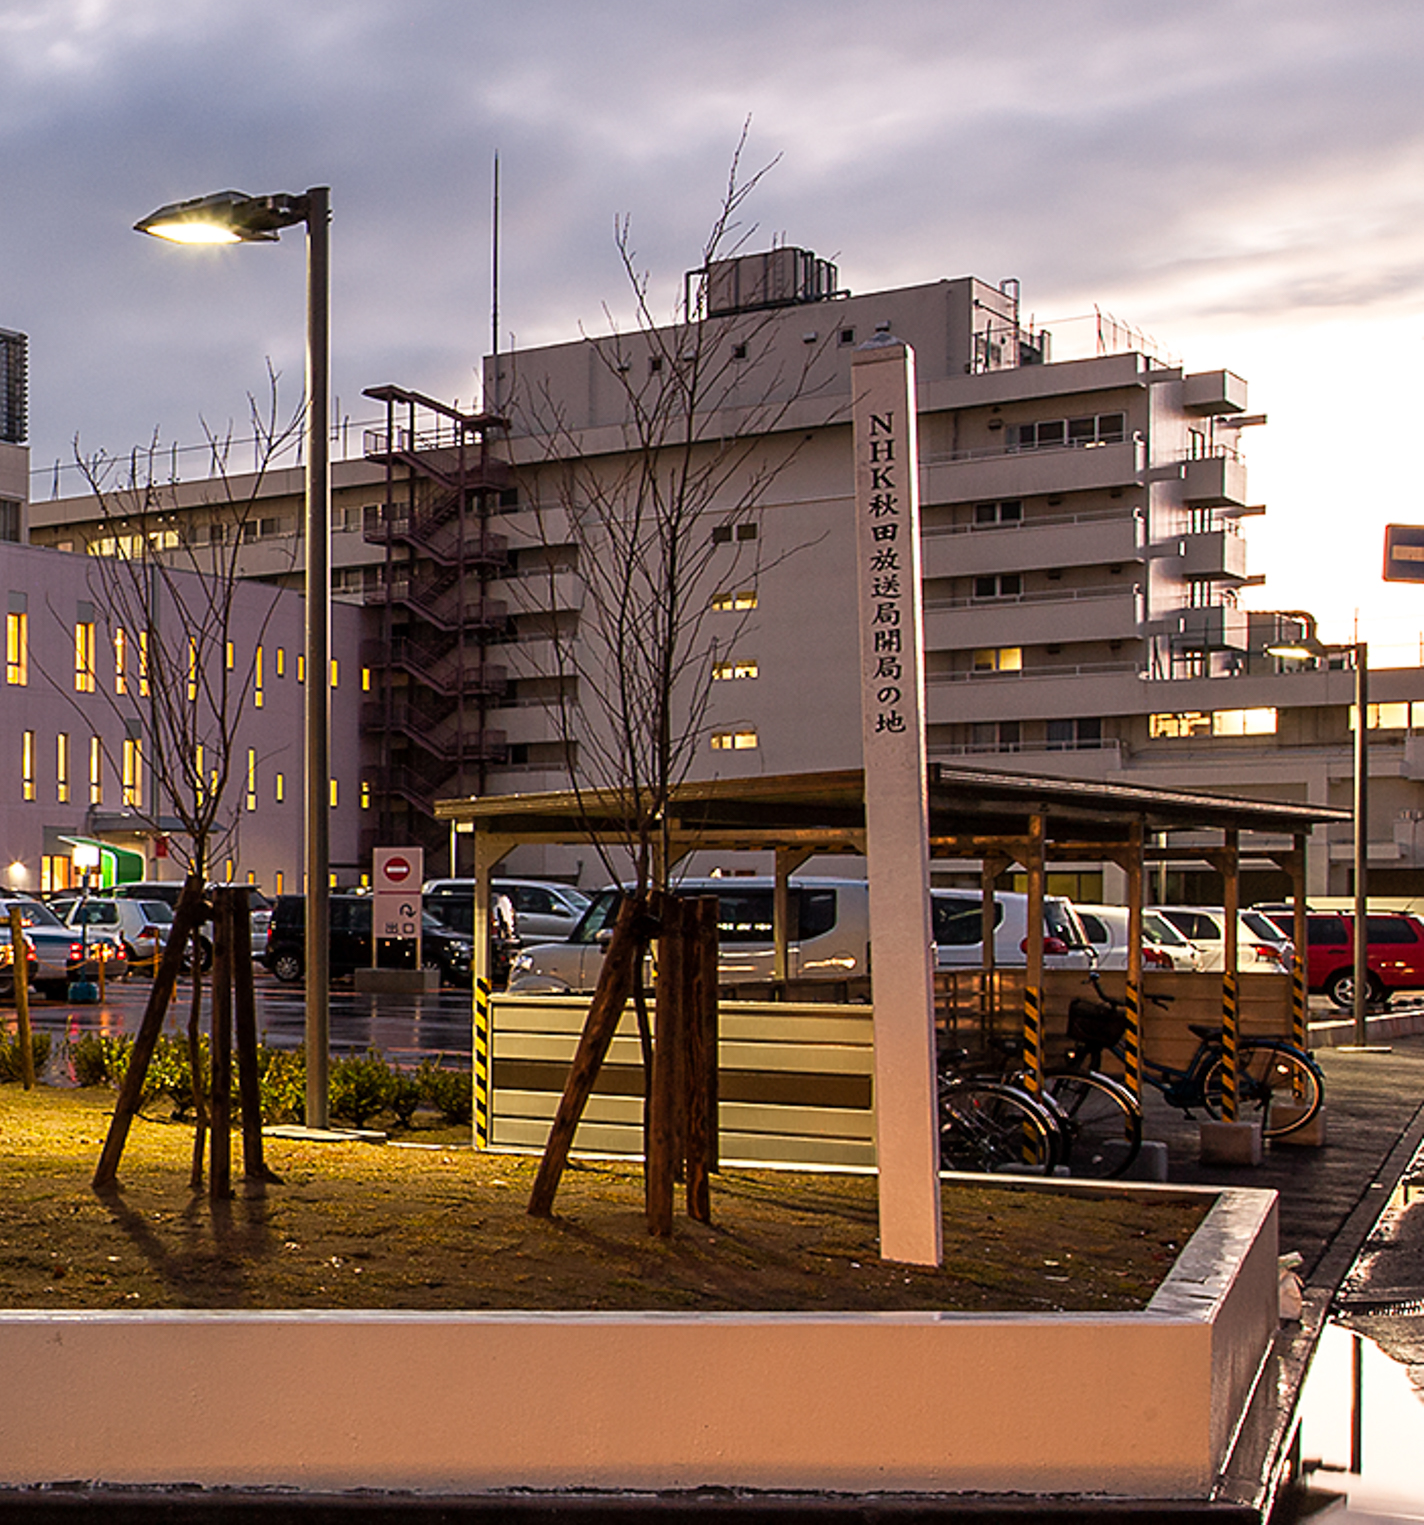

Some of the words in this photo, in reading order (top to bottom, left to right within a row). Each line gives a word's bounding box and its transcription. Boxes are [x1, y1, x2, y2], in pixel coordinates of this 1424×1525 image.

[868, 411, 907, 734] NHK秋田放送局開局の地
